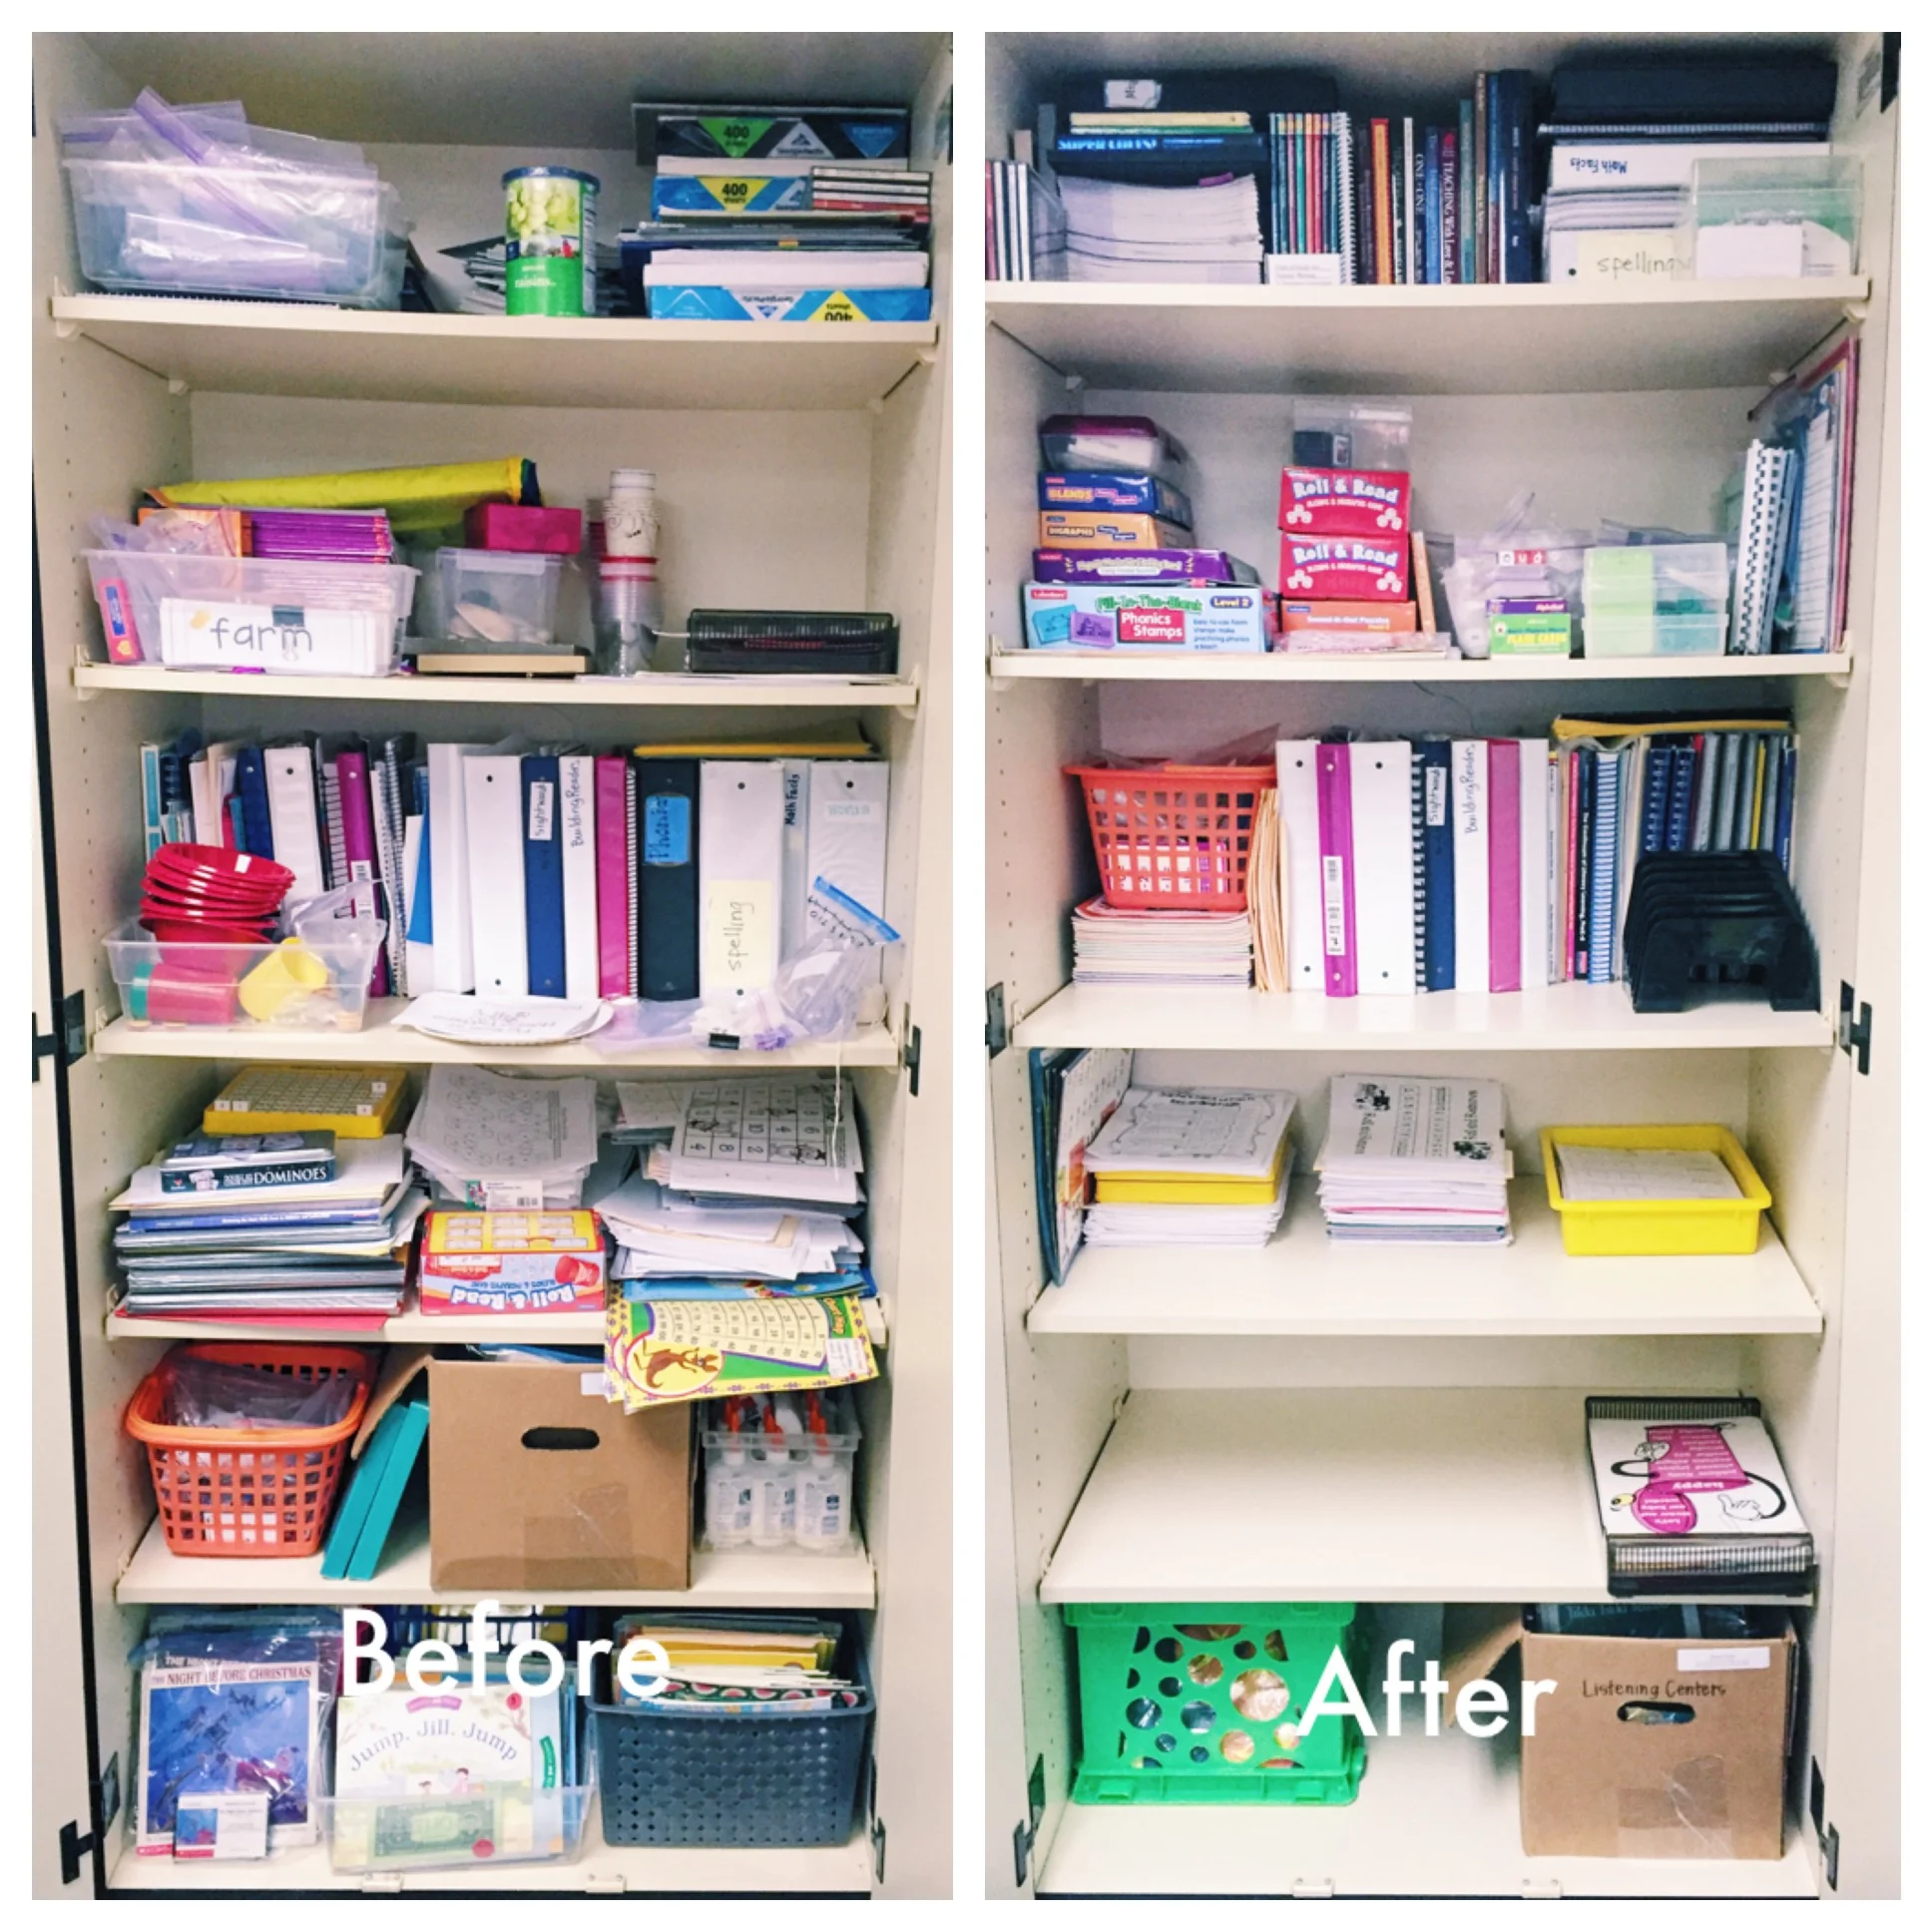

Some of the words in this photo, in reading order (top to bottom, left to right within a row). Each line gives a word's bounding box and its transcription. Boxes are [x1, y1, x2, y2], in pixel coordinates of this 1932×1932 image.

[723, 126, 749, 140] 400
[1570, 158, 1599, 175] Facts
[1601, 160, 1628, 174] Math
[723, 183, 748, 197] 400
[1443, 161, 1455, 215] TEACHING
[1293, 479, 1329, 498] Roll
[1333, 478, 1348, 493] &
[1353, 479, 1399, 503] Read
[1293, 545, 1329, 564] Roll
[1333, 544, 1348, 559] &
[1353, 545, 1398, 567] Read
[1213, 599, 1236, 608] Level
[1121, 613, 1172, 626] Phonics
[210, 617, 312, 653] farm
[1134, 625, 1184, 639] Stamps
[726, 900, 755, 971] spelling
[253, 1166, 327, 1186] DOMINOES
[451, 1285, 506, 1310] Read
[508, 1291, 527, 1309] &
[531, 1283, 575, 1308] Roll
[167, 1671, 202, 1686] NIGHT
[248, 1666, 311, 1681] CHRISTMAS
[1582, 1679, 1661, 1700] Listening
[1665, 1679, 1727, 1698] Centers
[462, 1721, 518, 1761] Jump
